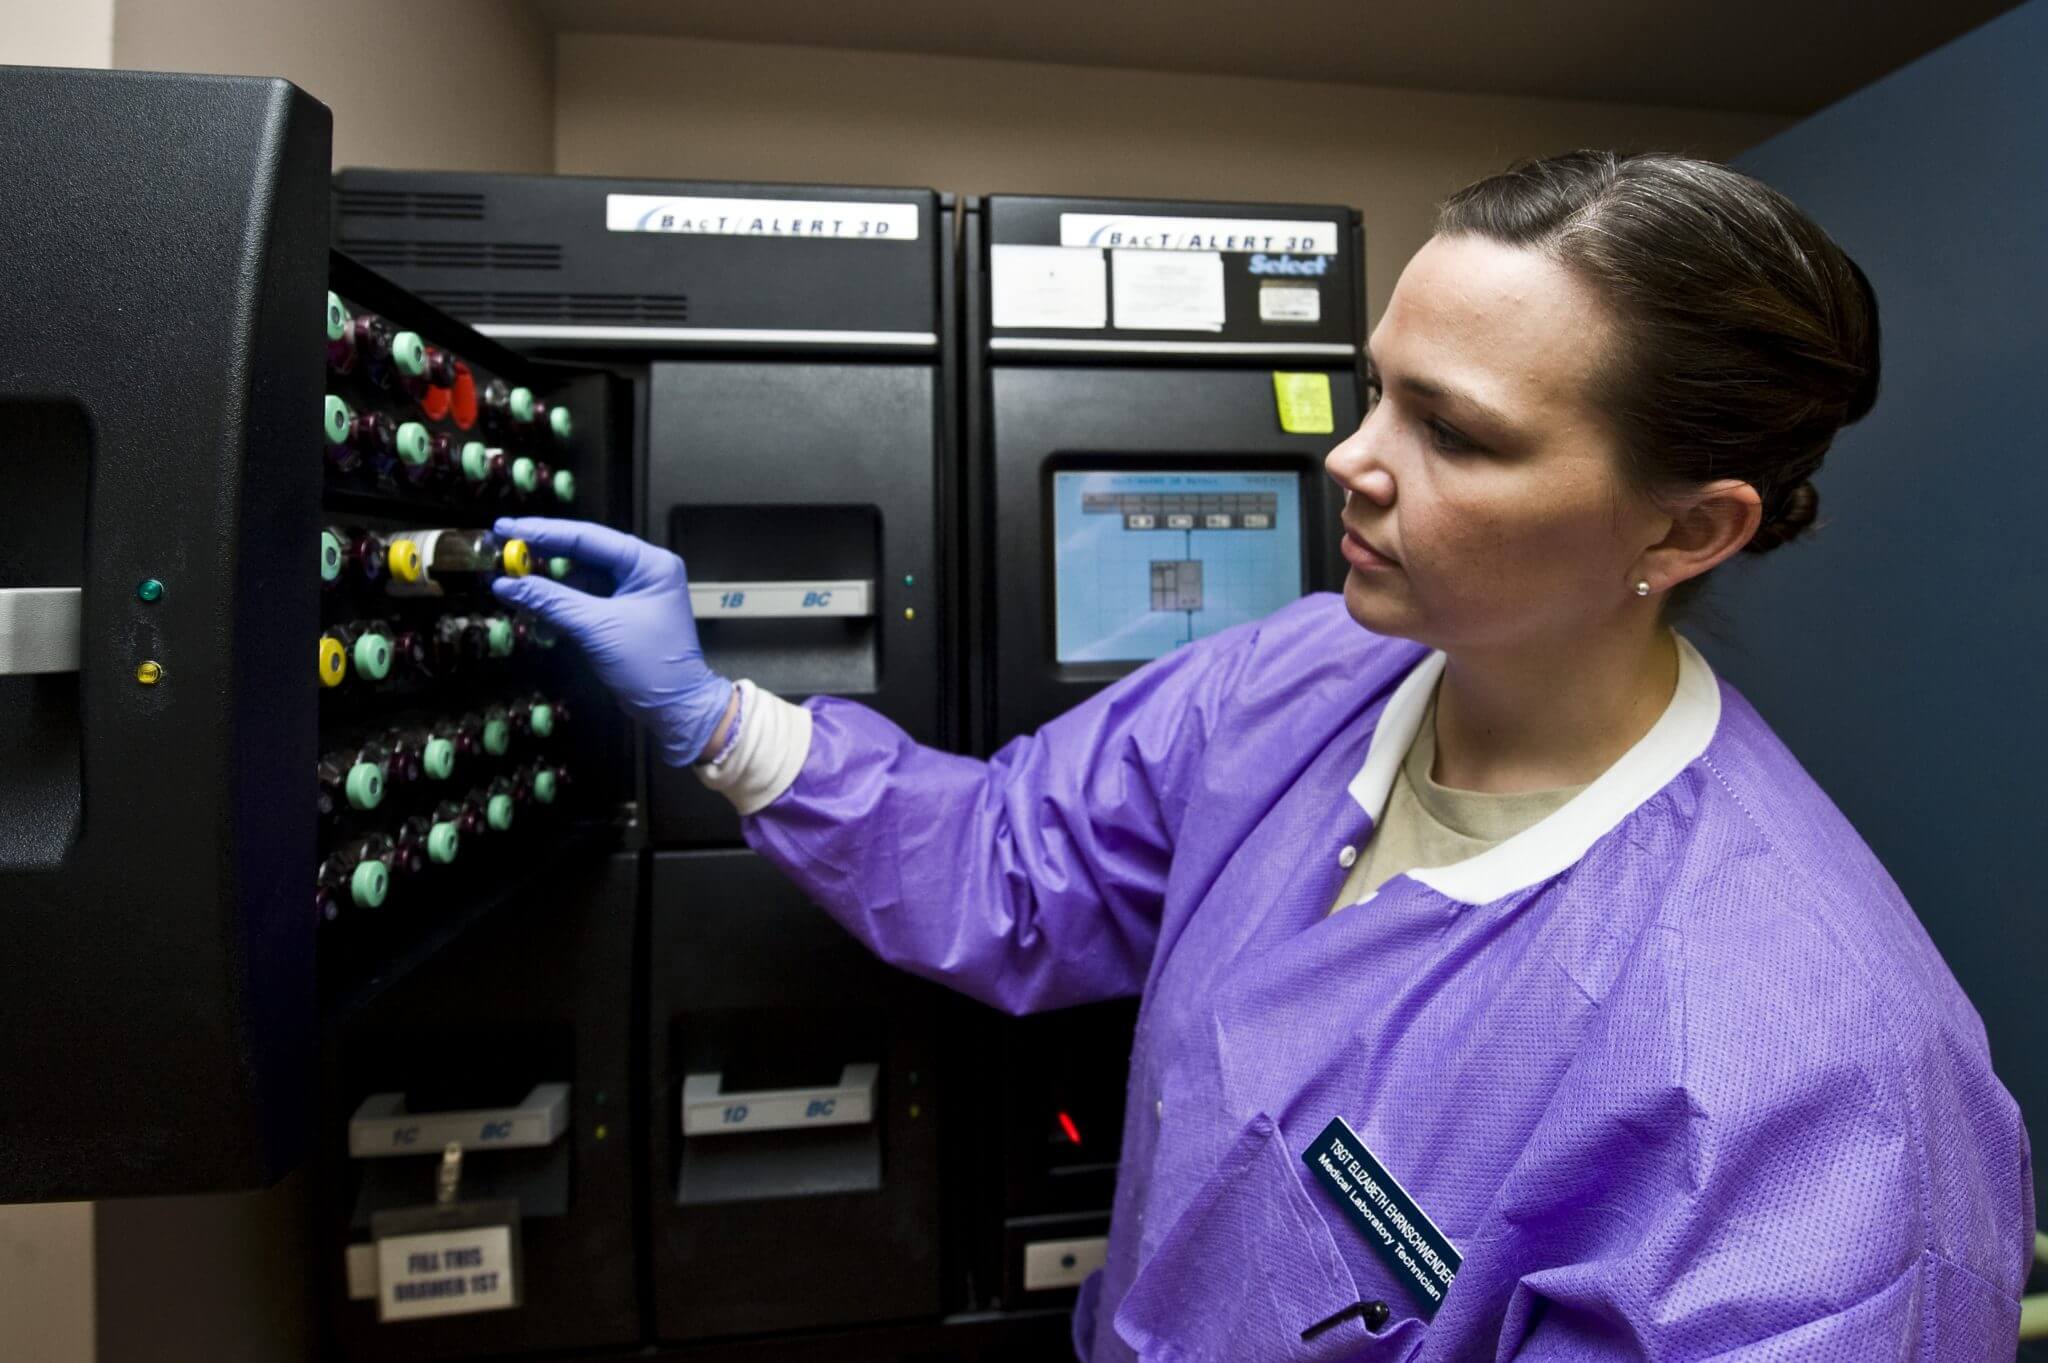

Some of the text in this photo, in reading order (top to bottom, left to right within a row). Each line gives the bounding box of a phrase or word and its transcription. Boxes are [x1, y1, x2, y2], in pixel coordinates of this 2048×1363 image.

[857, 220, 890, 235] 3D
[1285, 236, 1315, 252] 3D
[1249, 254, 1327, 276] Select
[720, 591, 832, 608] 1B BC
[723, 1100, 836, 1124] 1D BC
[1330, 1138, 1456, 1288] TSGT ELIZABETH EHRNSCHWENDER
[1318, 1153, 1441, 1301] Medical Laboratory Technician
